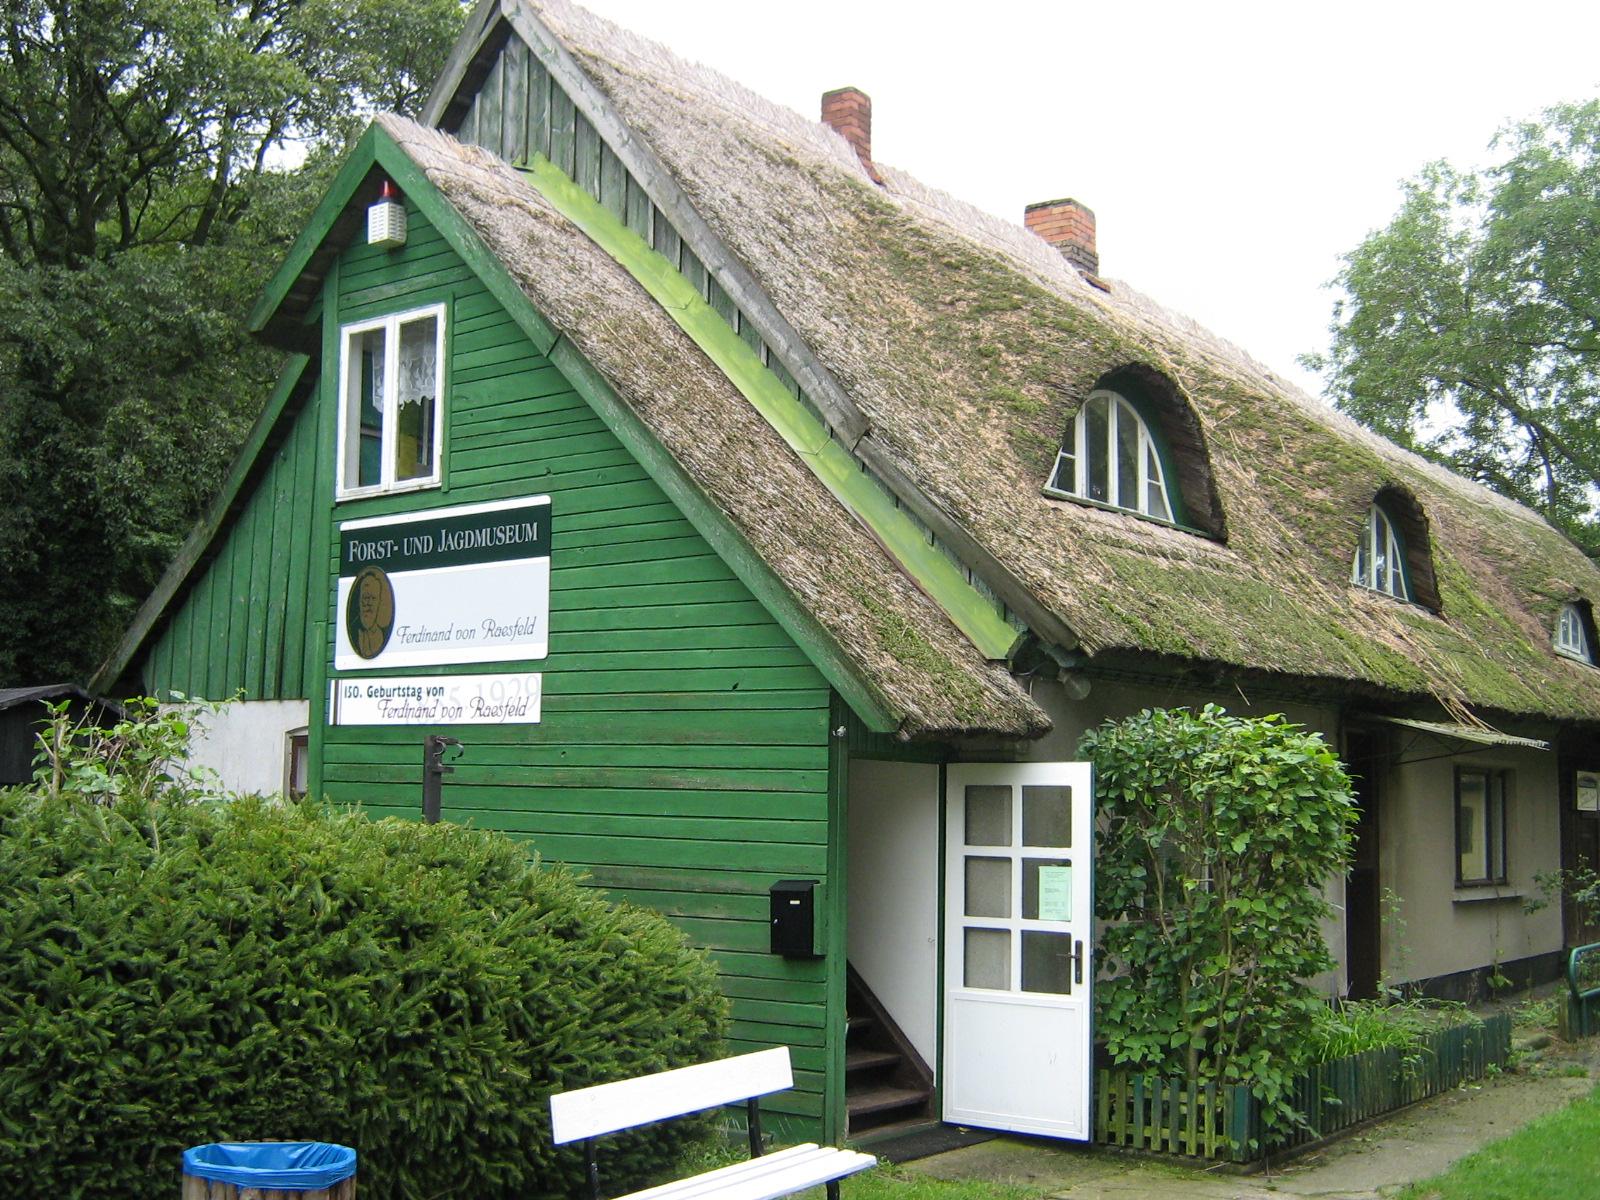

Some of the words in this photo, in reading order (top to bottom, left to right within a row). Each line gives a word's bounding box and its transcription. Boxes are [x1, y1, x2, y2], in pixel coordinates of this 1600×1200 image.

[404, 535, 433, 556] UND
[438, 522, 538, 553] JAGDMUSEUM
[396, 623, 453, 645] Ferdinand
[455, 628, 476, 640] von
[481, 616, 537, 641] Raesfeld
[366, 685, 422, 701] Geburtstag
[426, 686, 445, 697] von
[377, 698, 439, 719] Ferdinand
[442, 706, 462, 719] von
[470, 695, 530, 723] Raesfeld
